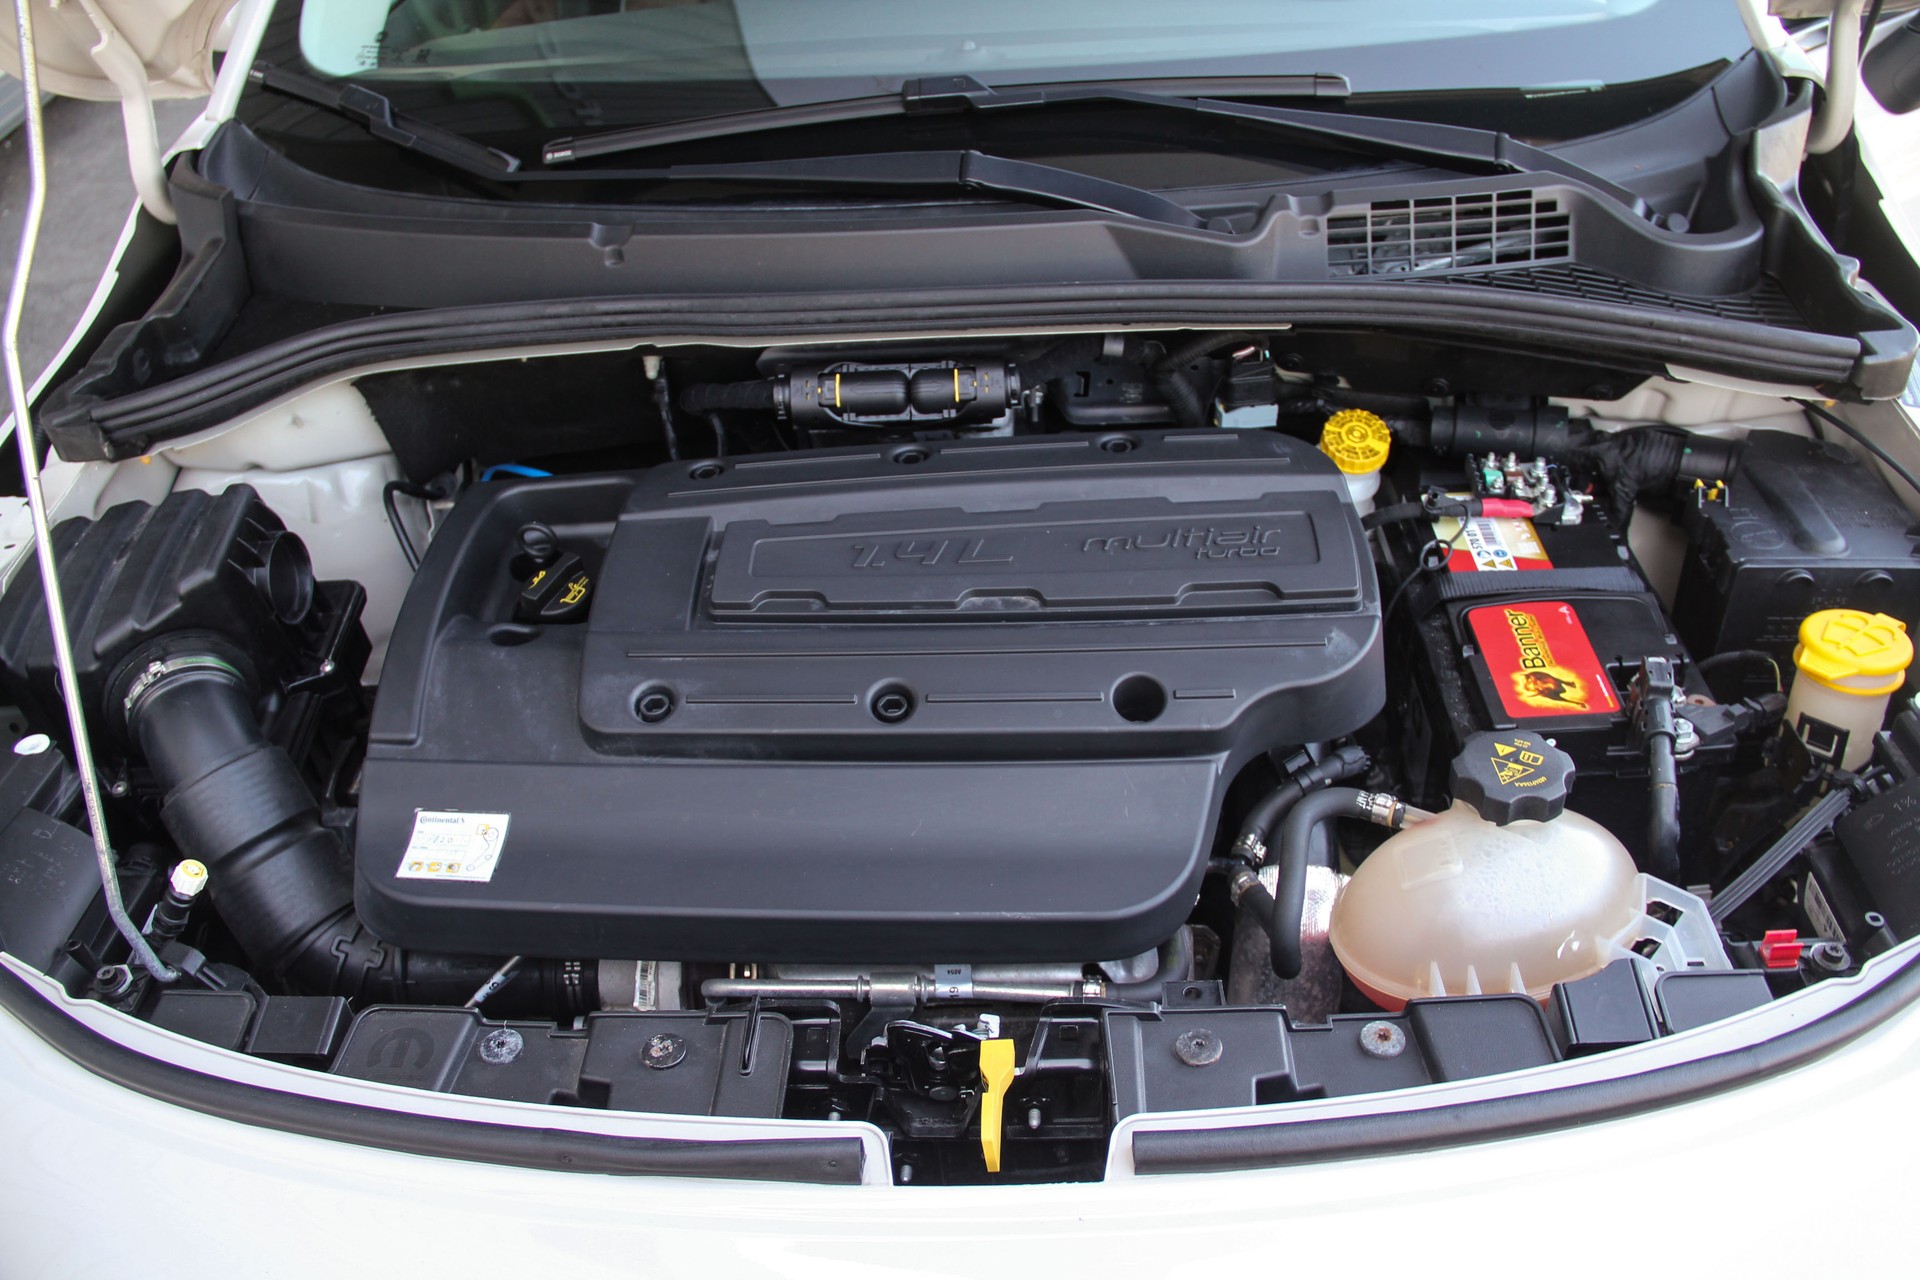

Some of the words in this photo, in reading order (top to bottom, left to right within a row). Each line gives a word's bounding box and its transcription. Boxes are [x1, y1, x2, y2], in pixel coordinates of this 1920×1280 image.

[1084, 525, 1281, 551] multiair
[1196, 548, 1281, 559] turbo
[1505, 608, 1546, 669] Banner
[420, 815, 460, 824] Continental
